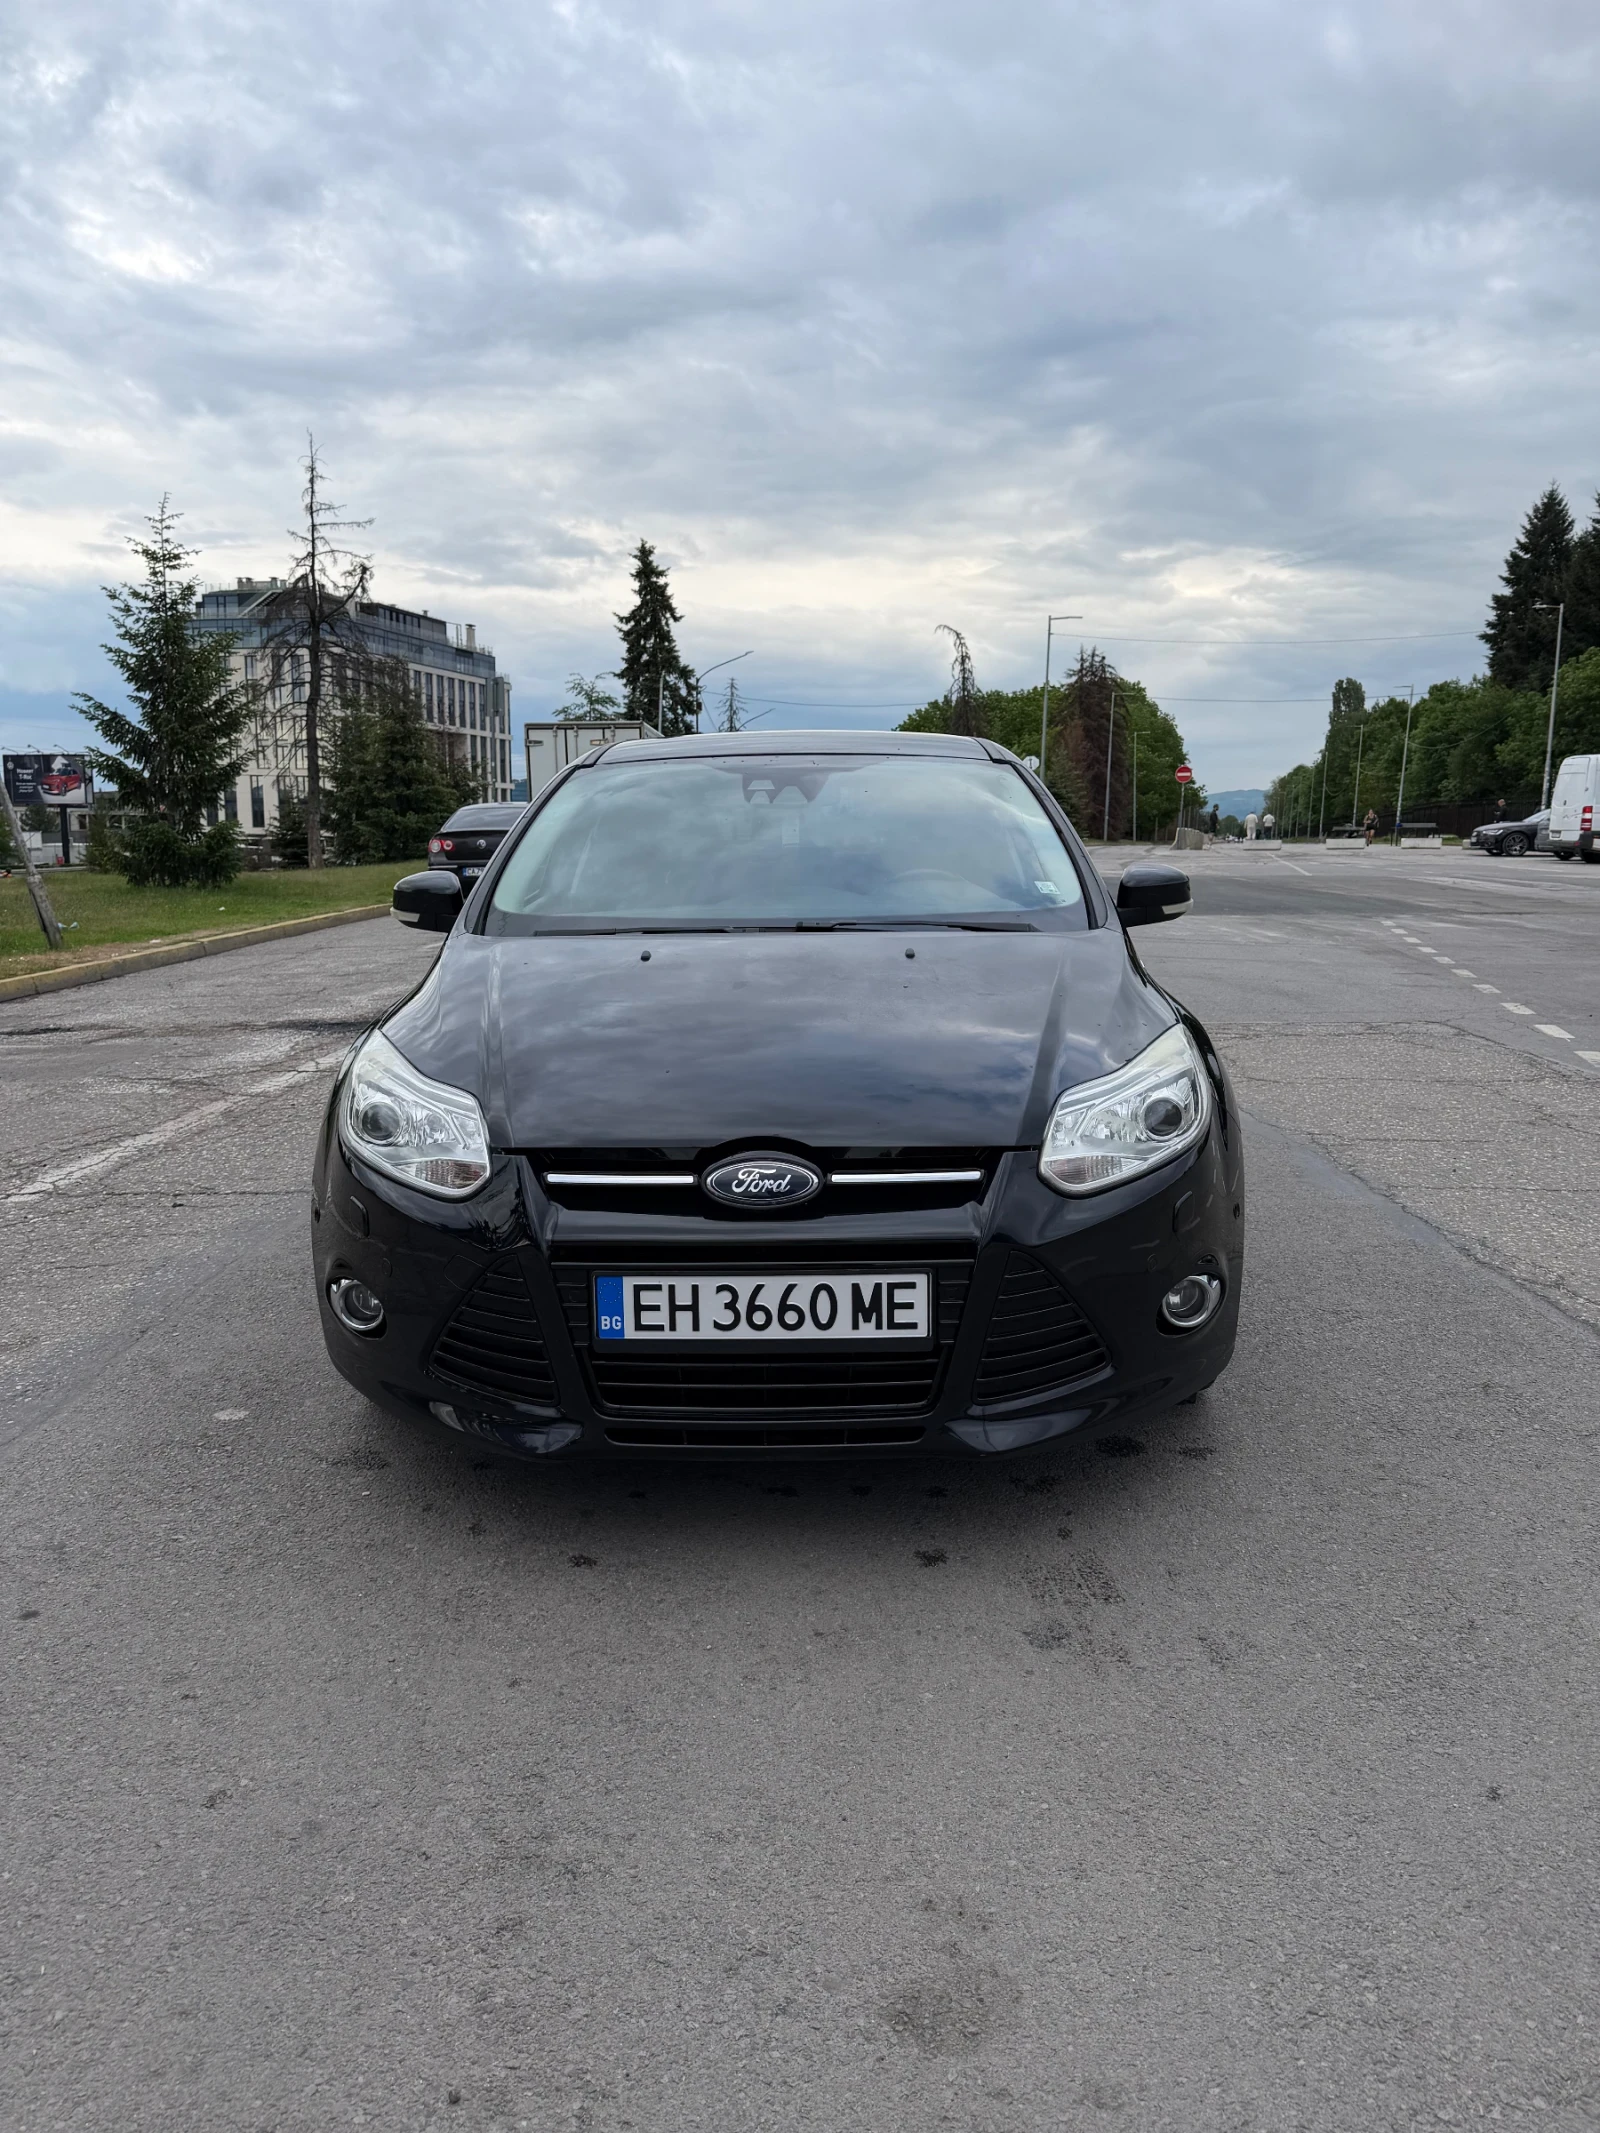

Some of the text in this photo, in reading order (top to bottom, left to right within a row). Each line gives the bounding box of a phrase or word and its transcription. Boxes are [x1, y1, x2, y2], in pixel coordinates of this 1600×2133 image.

[731, 1167, 792, 1193] Ford
[633, 1282, 918, 1332] EH 3660 ME
[601, 1315, 622, 1330] BG
